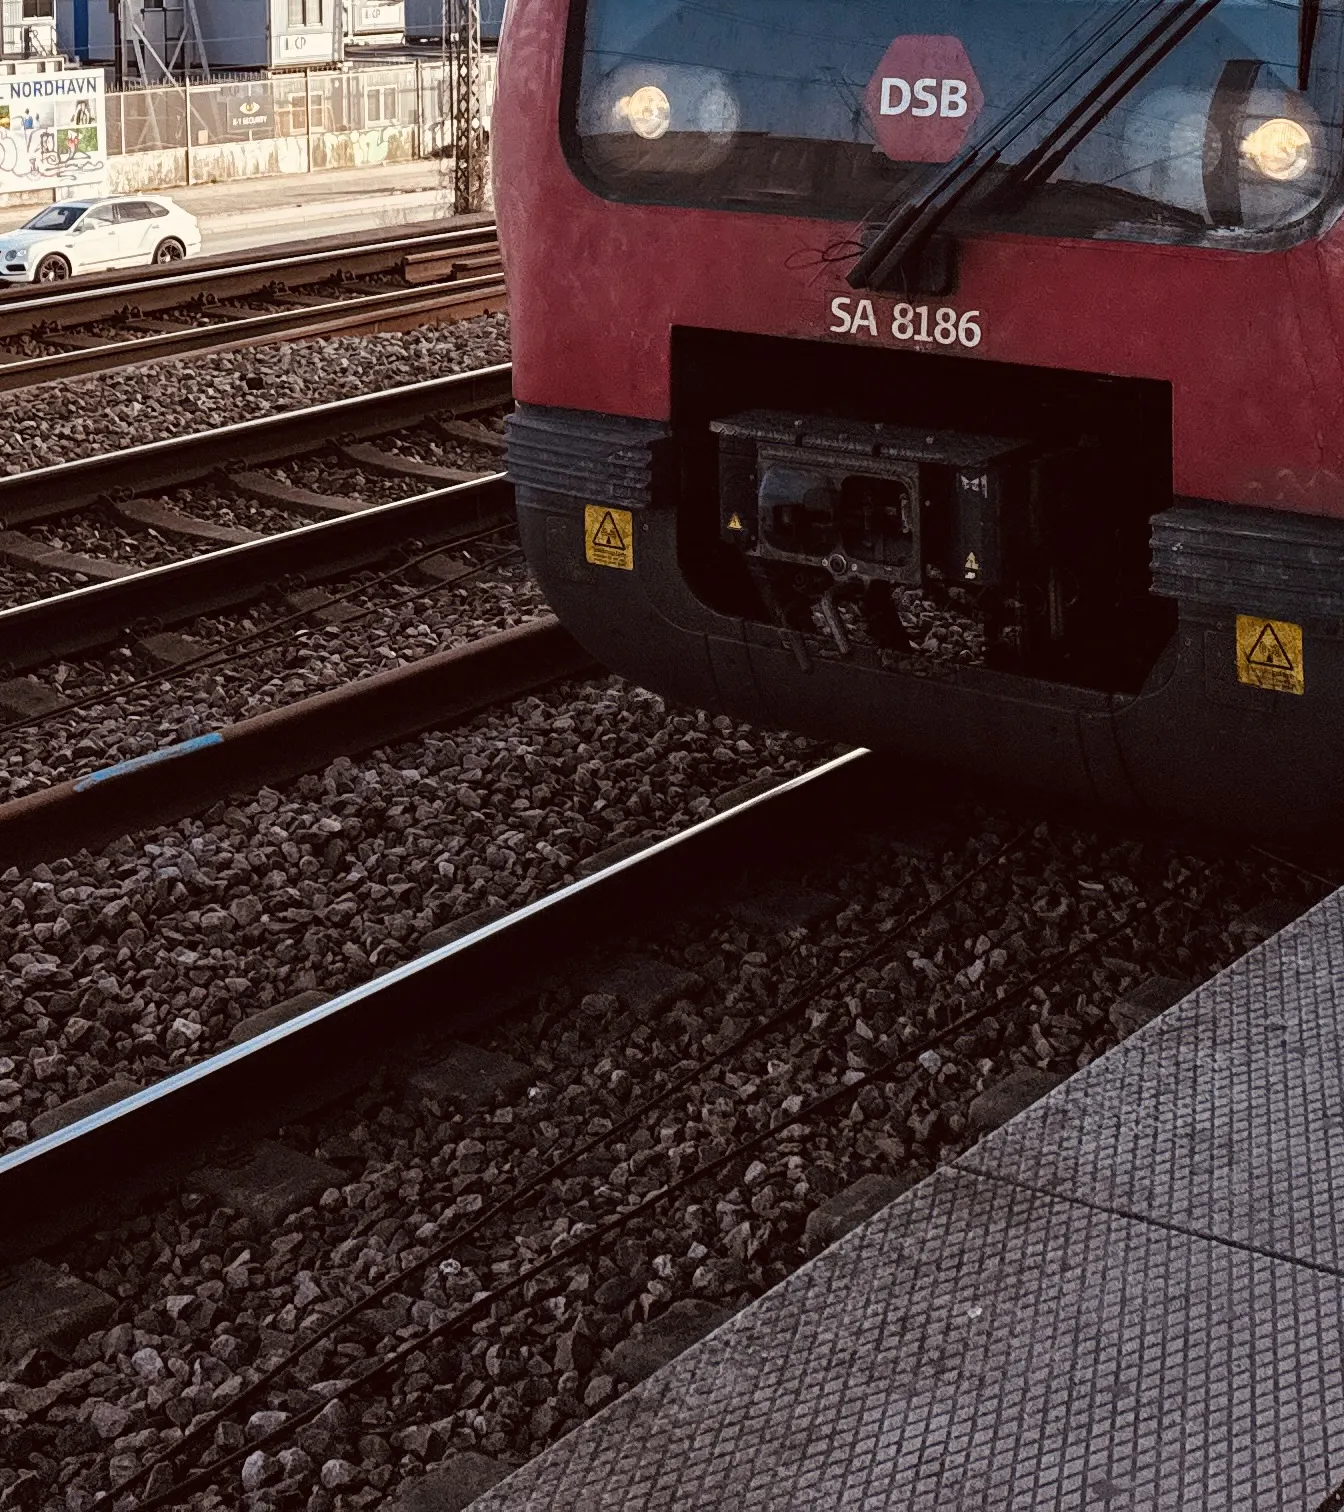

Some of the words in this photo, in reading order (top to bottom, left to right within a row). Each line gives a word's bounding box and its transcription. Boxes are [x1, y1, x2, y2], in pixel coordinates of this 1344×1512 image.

[10, 77, 97, 99] NORDHAVN
[879, 77, 969, 118] DSB
[829, 296, 878, 337] SA
[891, 302, 982, 348] 8186
